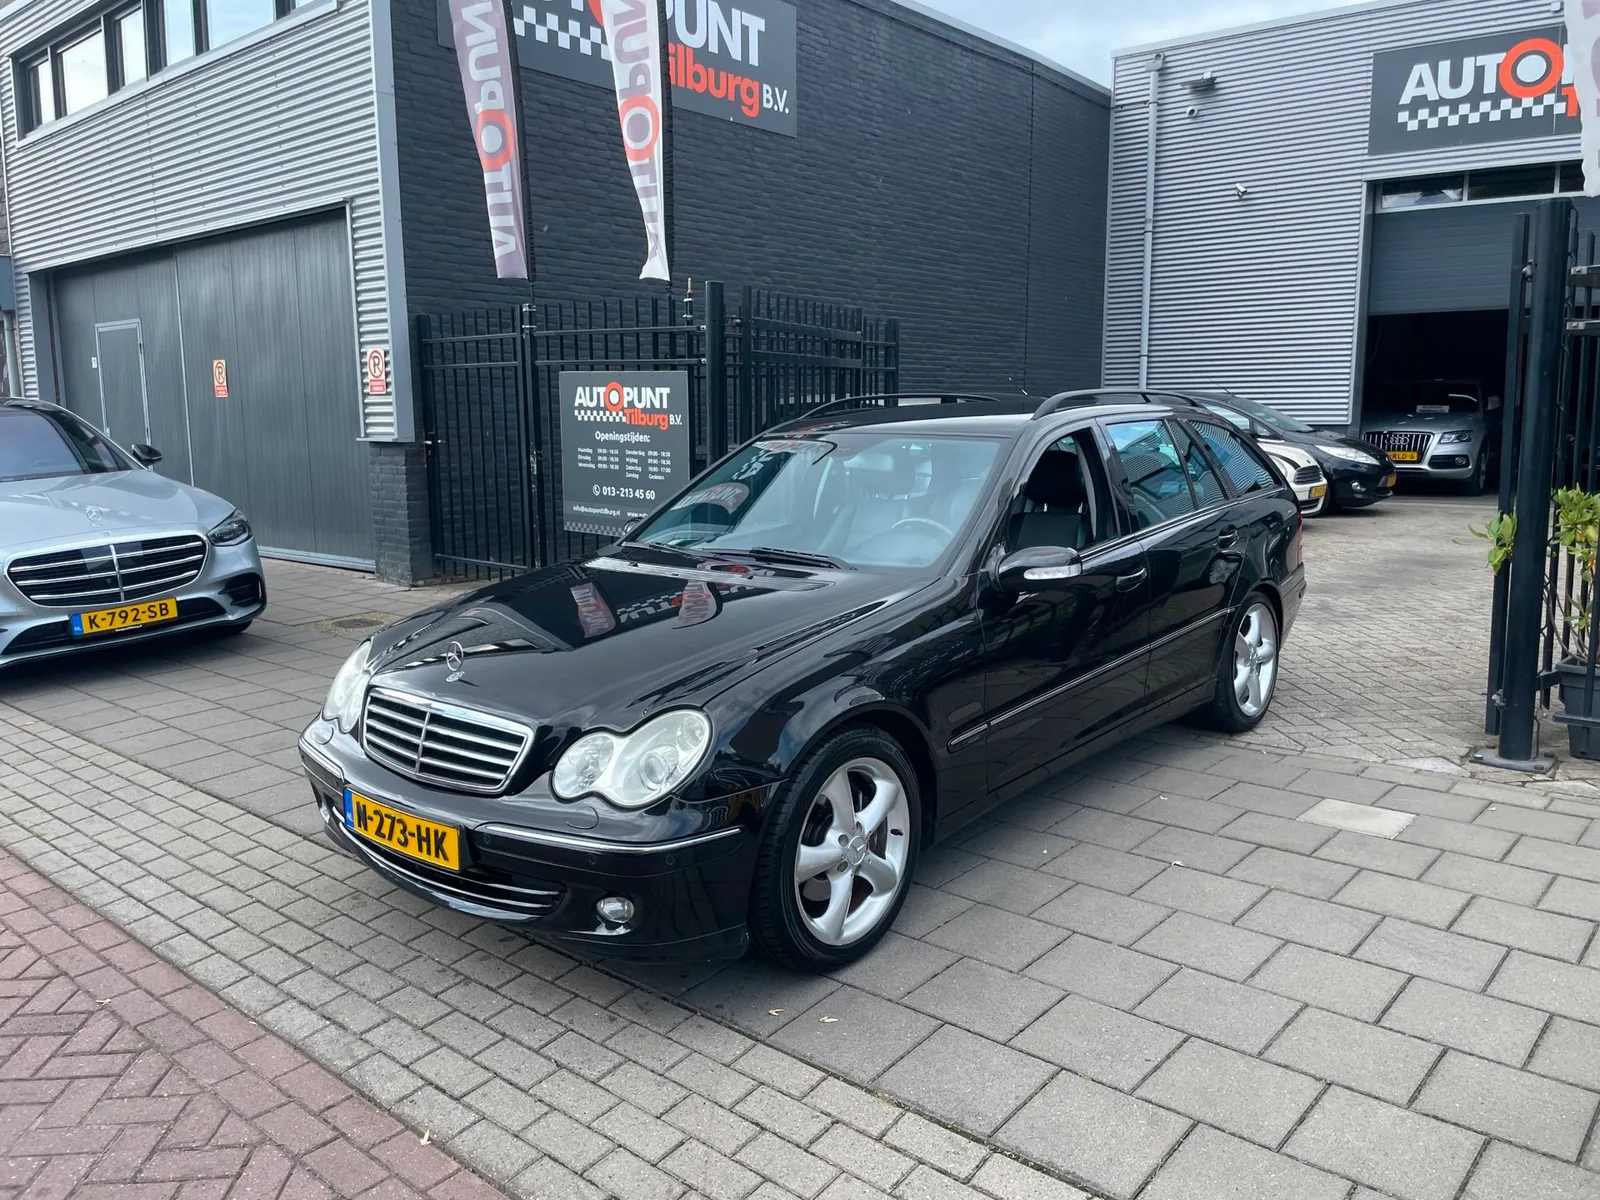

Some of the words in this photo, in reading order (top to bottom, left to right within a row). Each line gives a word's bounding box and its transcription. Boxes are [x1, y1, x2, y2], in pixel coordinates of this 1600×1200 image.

[762, 83, 789, 114] B.V.
[574, 381, 671, 412] AUTOPUNT
[623, 408, 669, 431] Tilburg
[669, 414, 682, 425] B.V.
[595, 431, 651, 443] Openingstijden:
[634, 488, 644, 499] 45
[645, 490, 656, 500] 60
[88, 602, 169, 630] K-792-SB
[356, 801, 449, 861] N-273-HK
